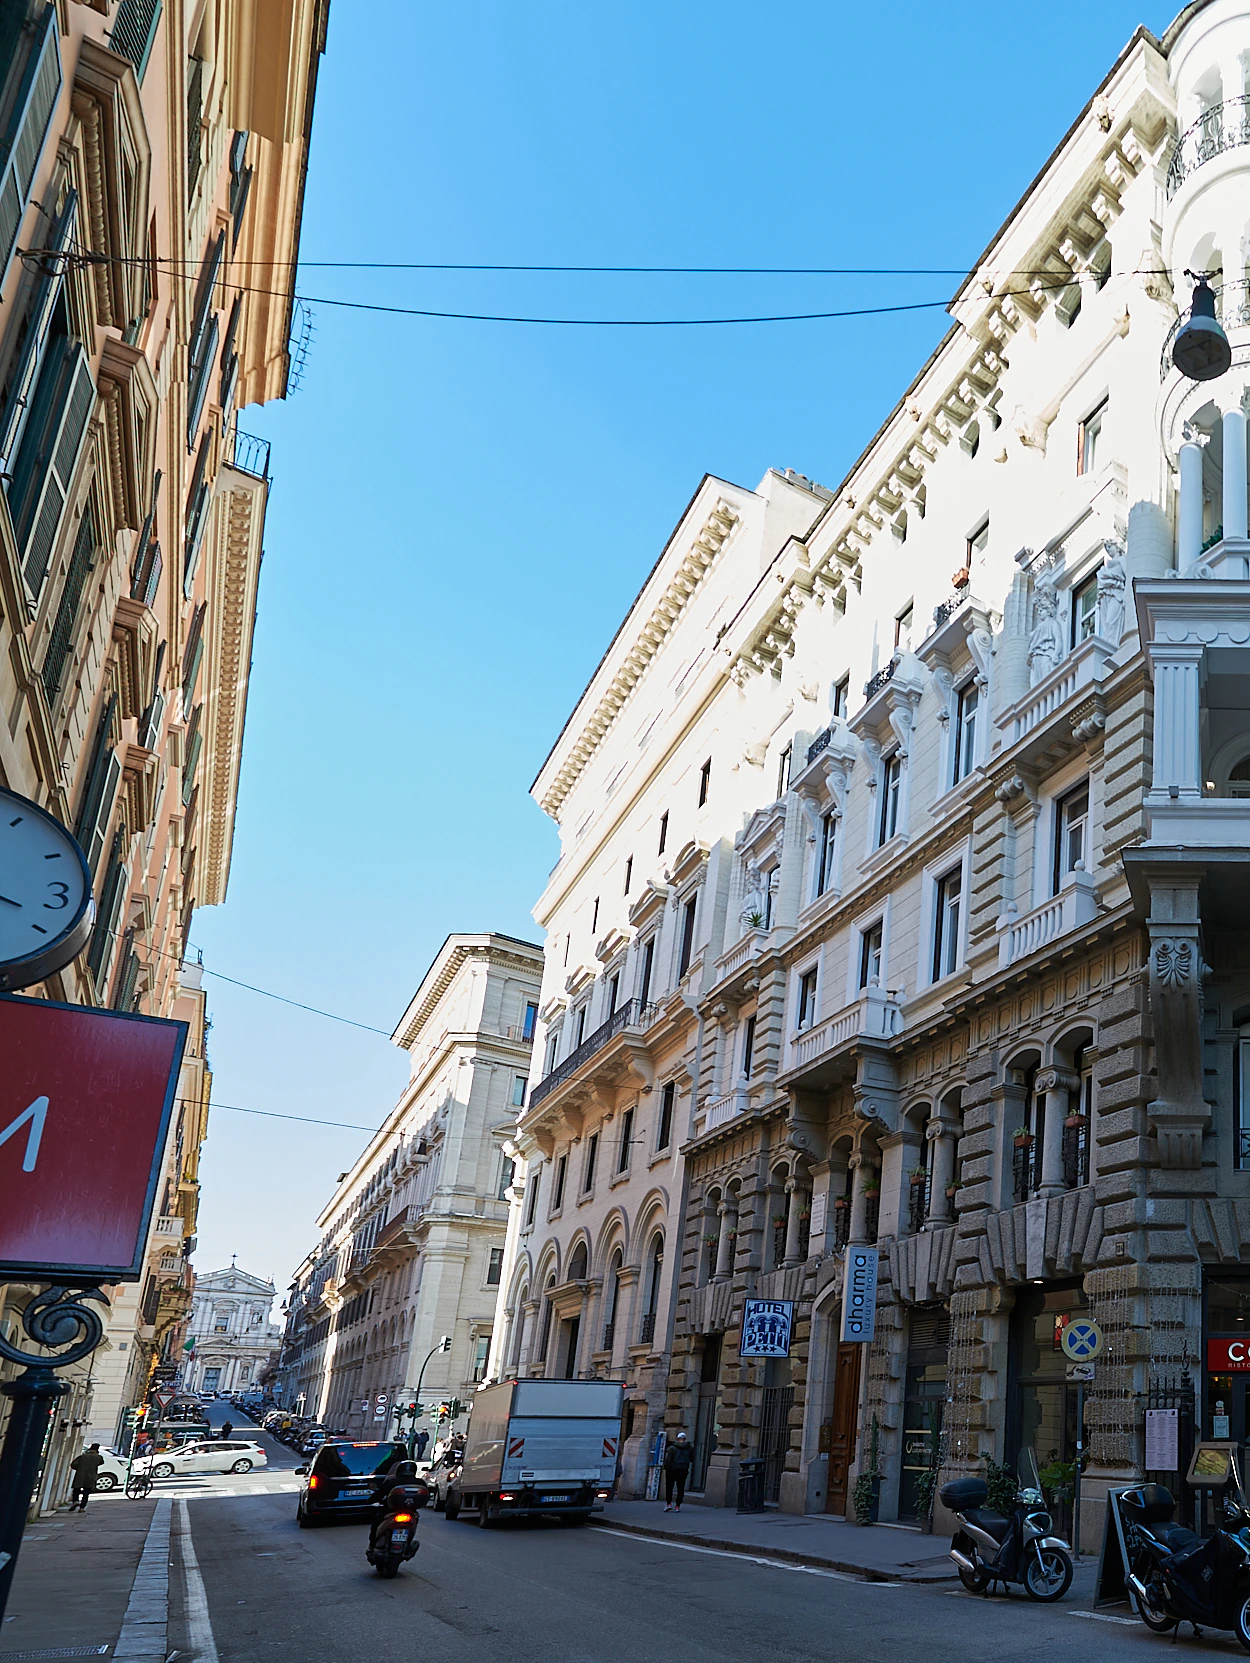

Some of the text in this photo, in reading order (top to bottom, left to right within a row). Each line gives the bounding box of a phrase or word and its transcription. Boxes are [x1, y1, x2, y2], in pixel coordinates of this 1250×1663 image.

[43, 881, 70, 910] 3
[847, 1255, 867, 1334] dharma
[862, 1255, 875, 1334] luxury house
[747, 1302, 789, 1321] HOTEL
[743, 1330, 788, 1352] PETIT
